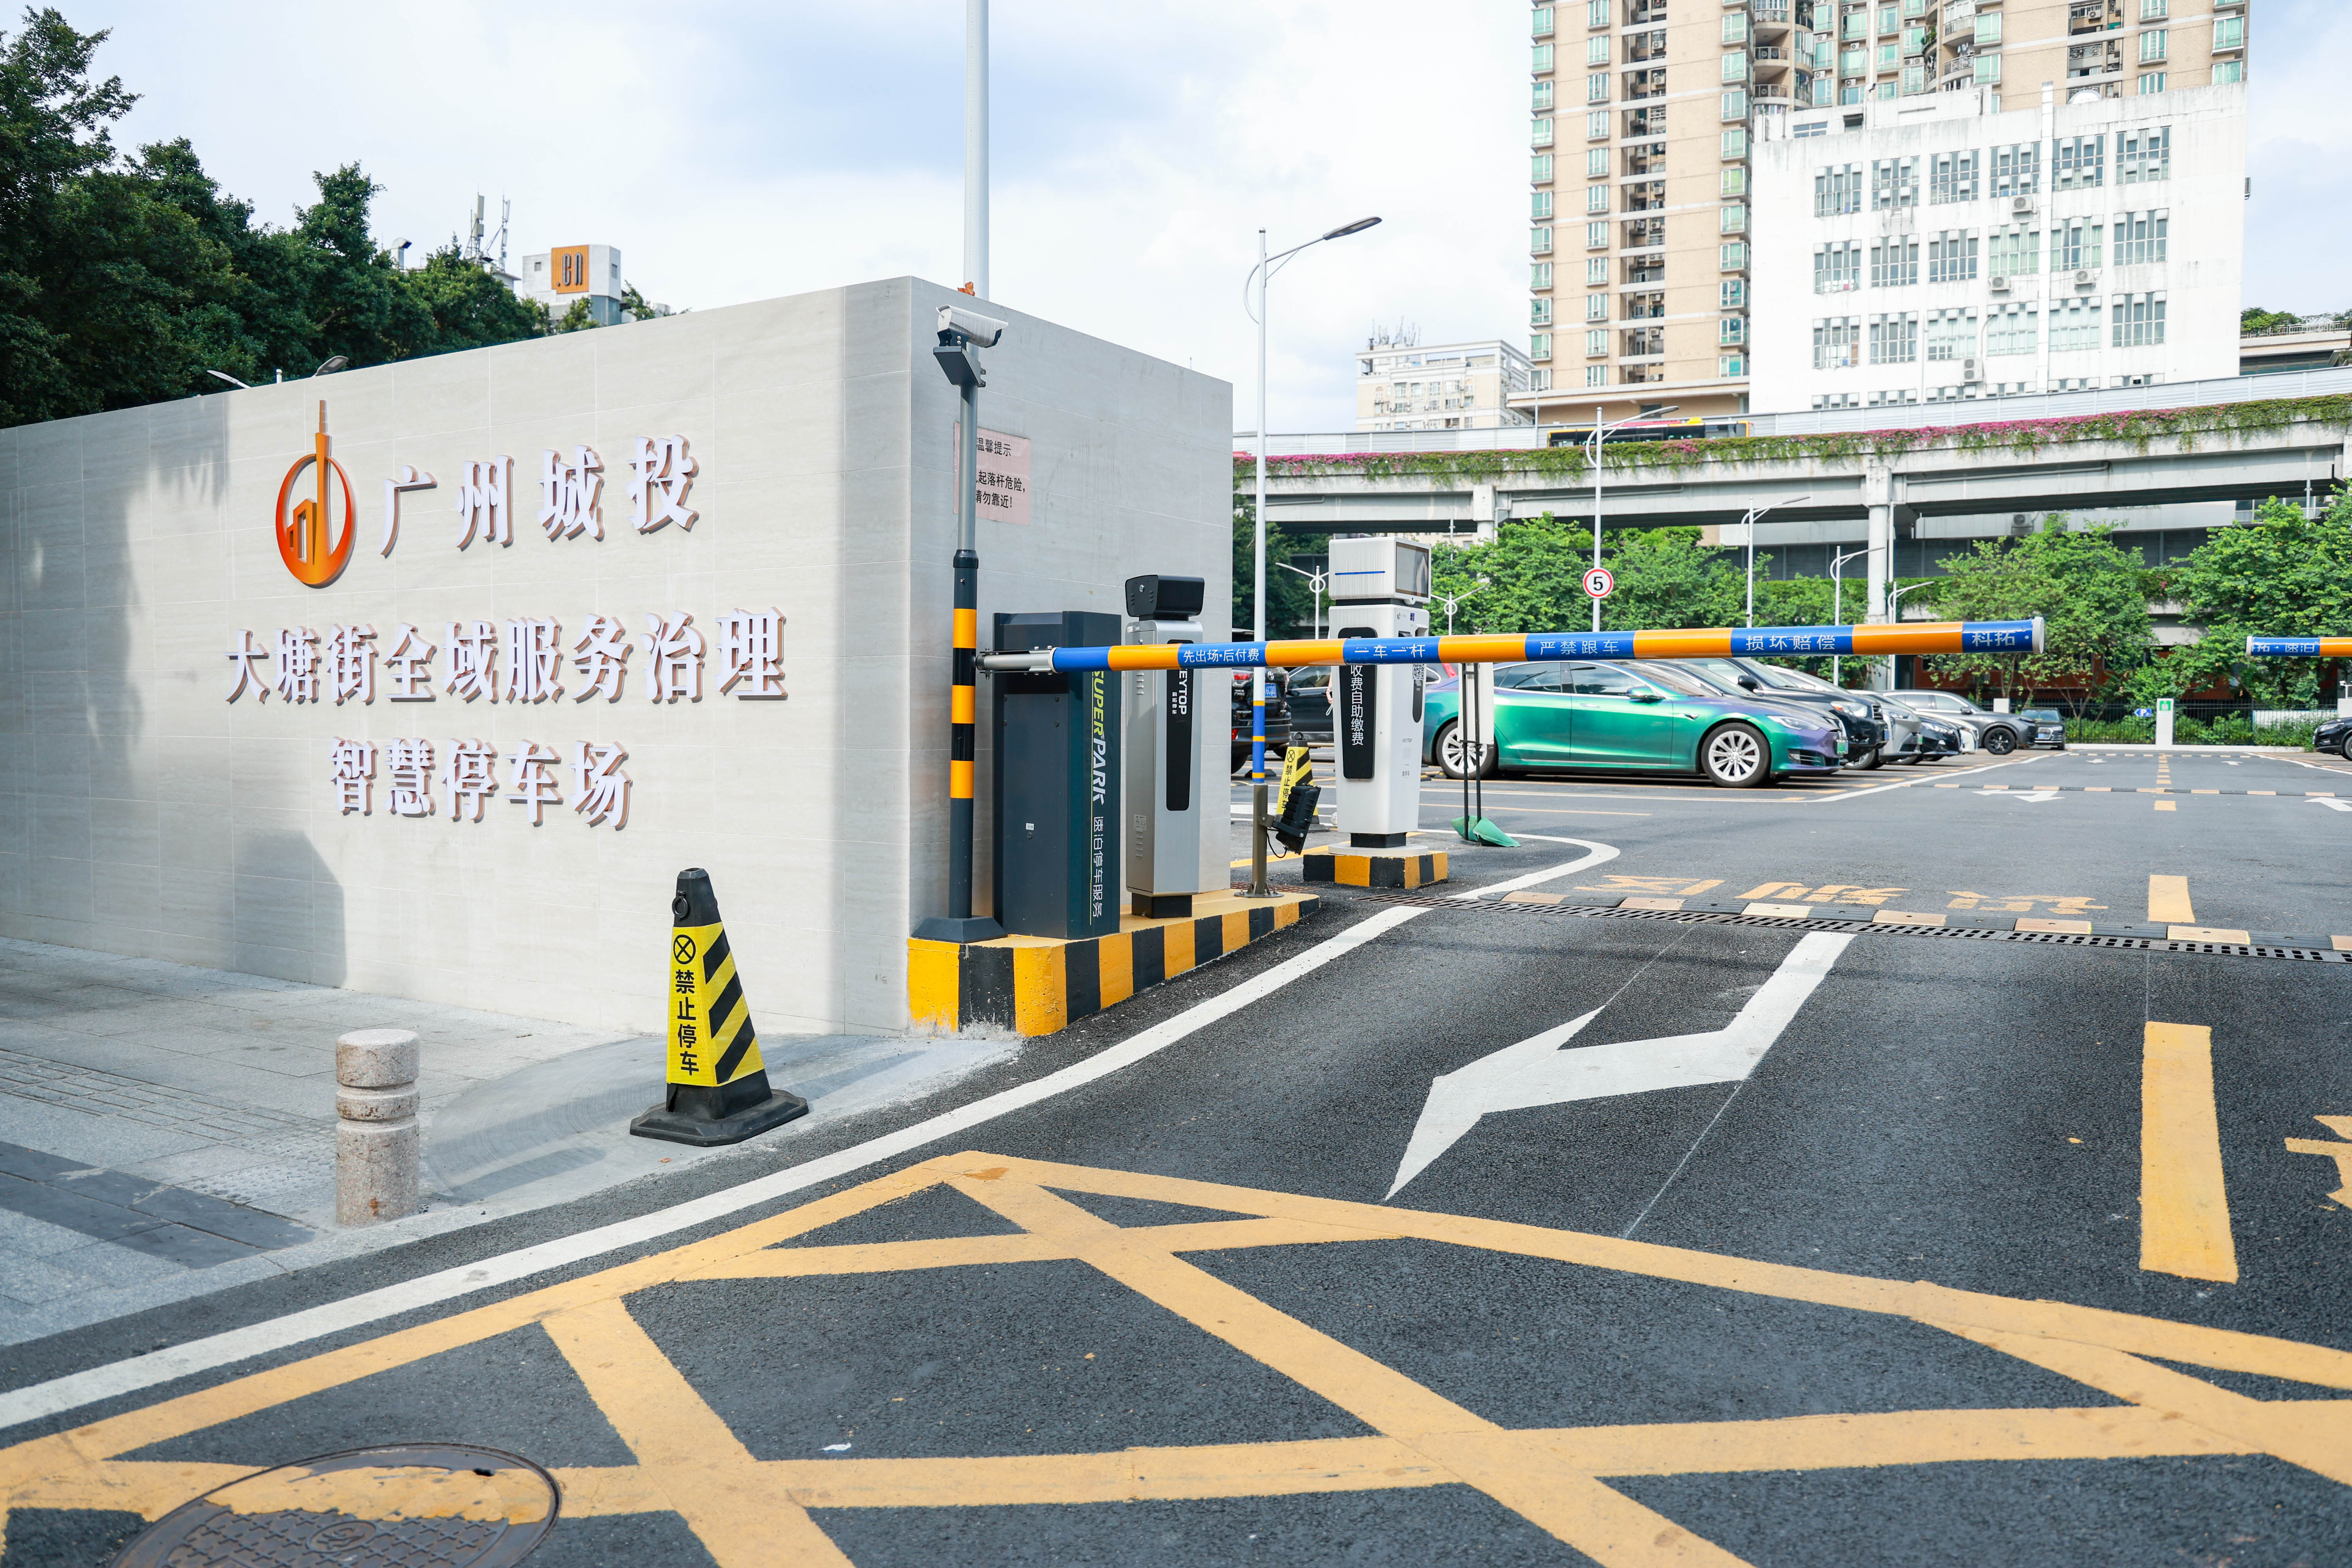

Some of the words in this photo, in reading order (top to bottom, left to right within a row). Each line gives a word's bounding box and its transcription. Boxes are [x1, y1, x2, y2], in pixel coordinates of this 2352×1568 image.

[976, 437, 1011, 457] 温馨提示
[380, 434, 699, 557] 广州城投
[976, 470, 1025, 492] 起落杆危险，
[1593, 576, 1603, 591] 5
[224, 606, 788, 704] 大塘街全域服务治理
[1354, 644, 1426, 659] 一车一杆
[1540, 639, 1619, 655] 严禁跟车
[1746, 634, 1835, 651] 损坏赔偿
[1178, 669, 1188, 715] EYTOP
[1350, 636, 1364, 746] 收费自助缴费
[329, 736, 632, 830] 智慧停车场
[675, 969, 699, 1076] 禁止停车
